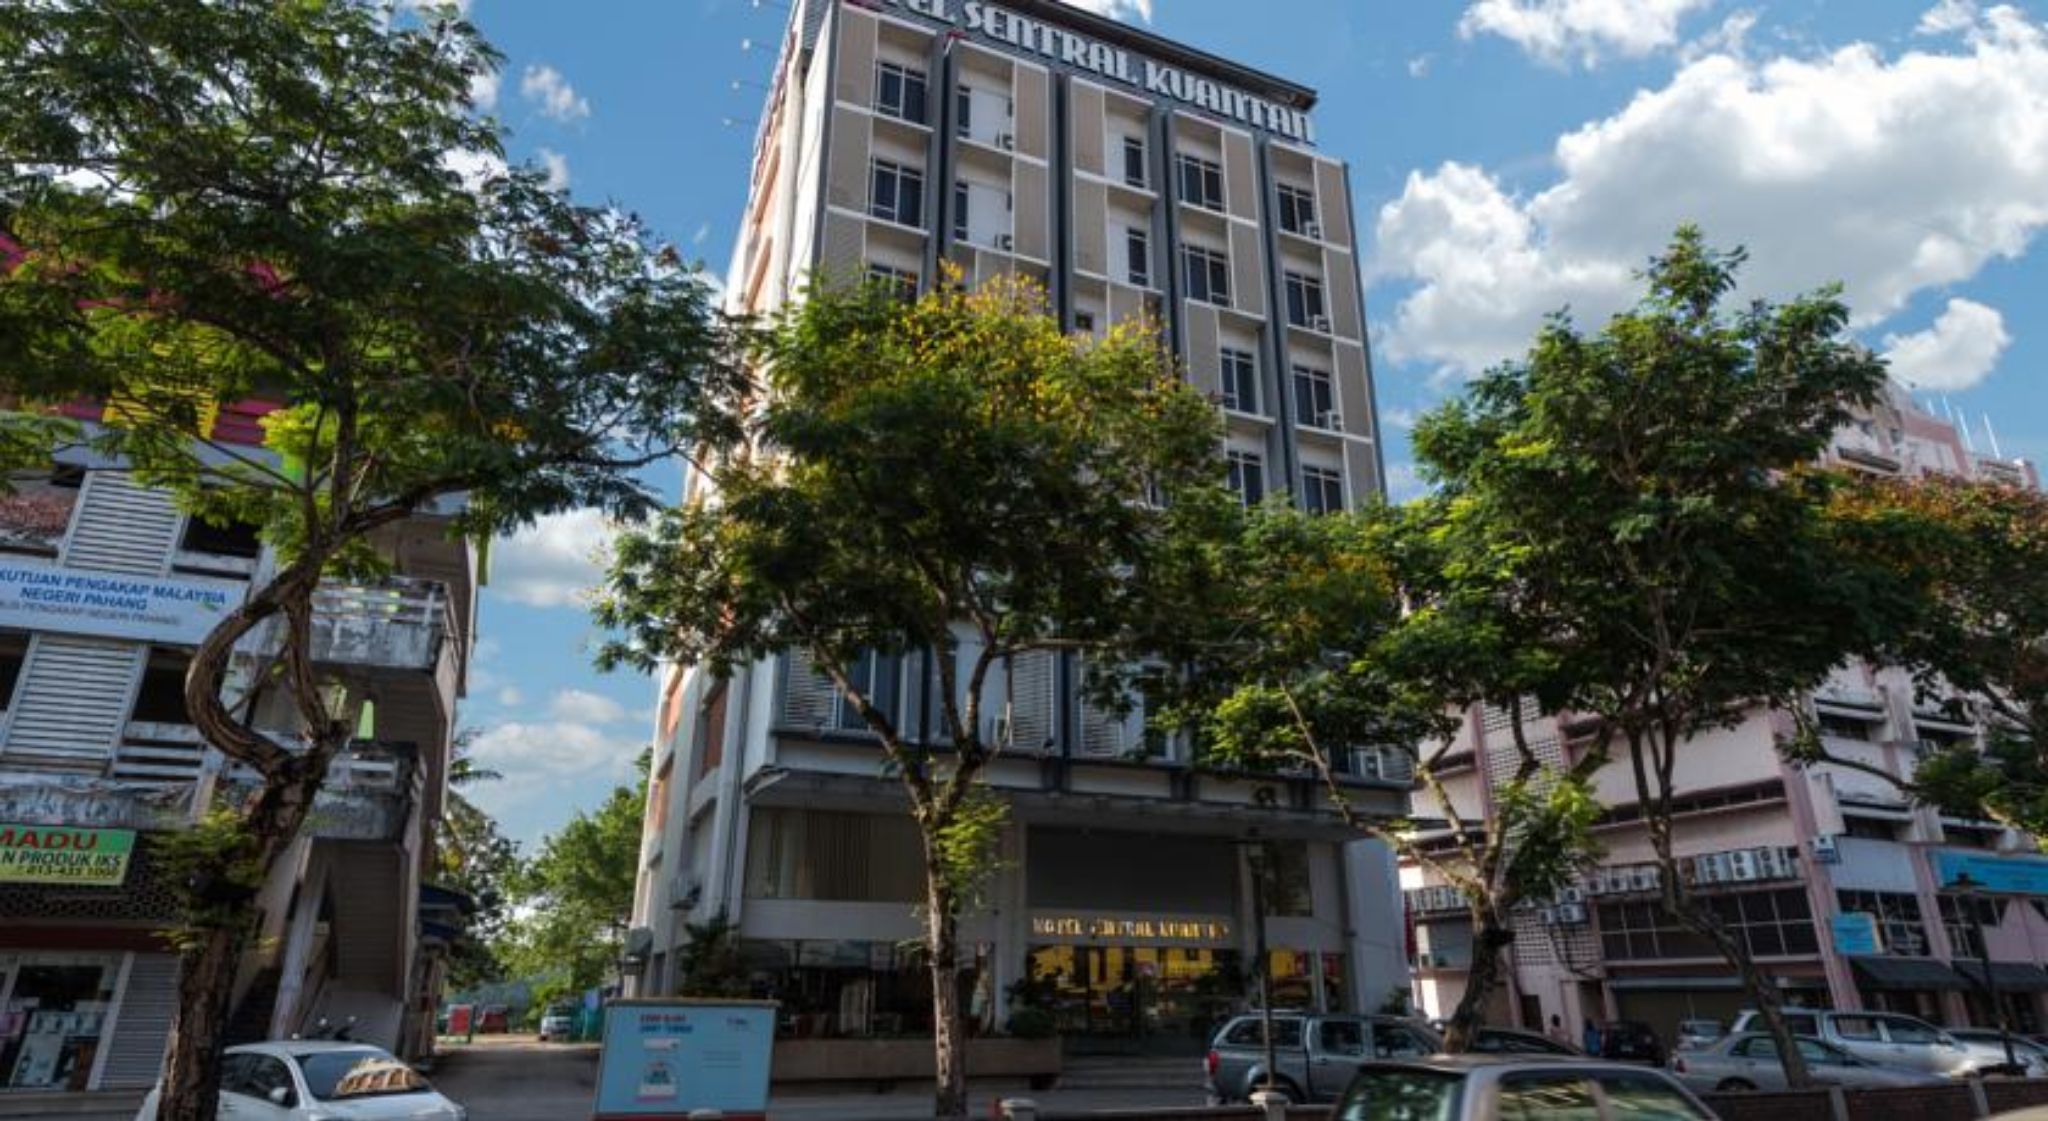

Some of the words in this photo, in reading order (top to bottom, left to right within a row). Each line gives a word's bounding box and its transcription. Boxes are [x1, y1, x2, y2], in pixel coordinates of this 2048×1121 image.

[964, 2, 1138, 84] SENTRAL
[1145, 60, 1316, 145] KUANTAN
[20, 587, 81, 603] NEGERI
[82, 592, 148, 610] PAHANG
[65, 577, 150, 595] PENGAKAP
[153, 586, 226, 605] MALAYSIA
[20, 851, 90, 866] PRODUK
